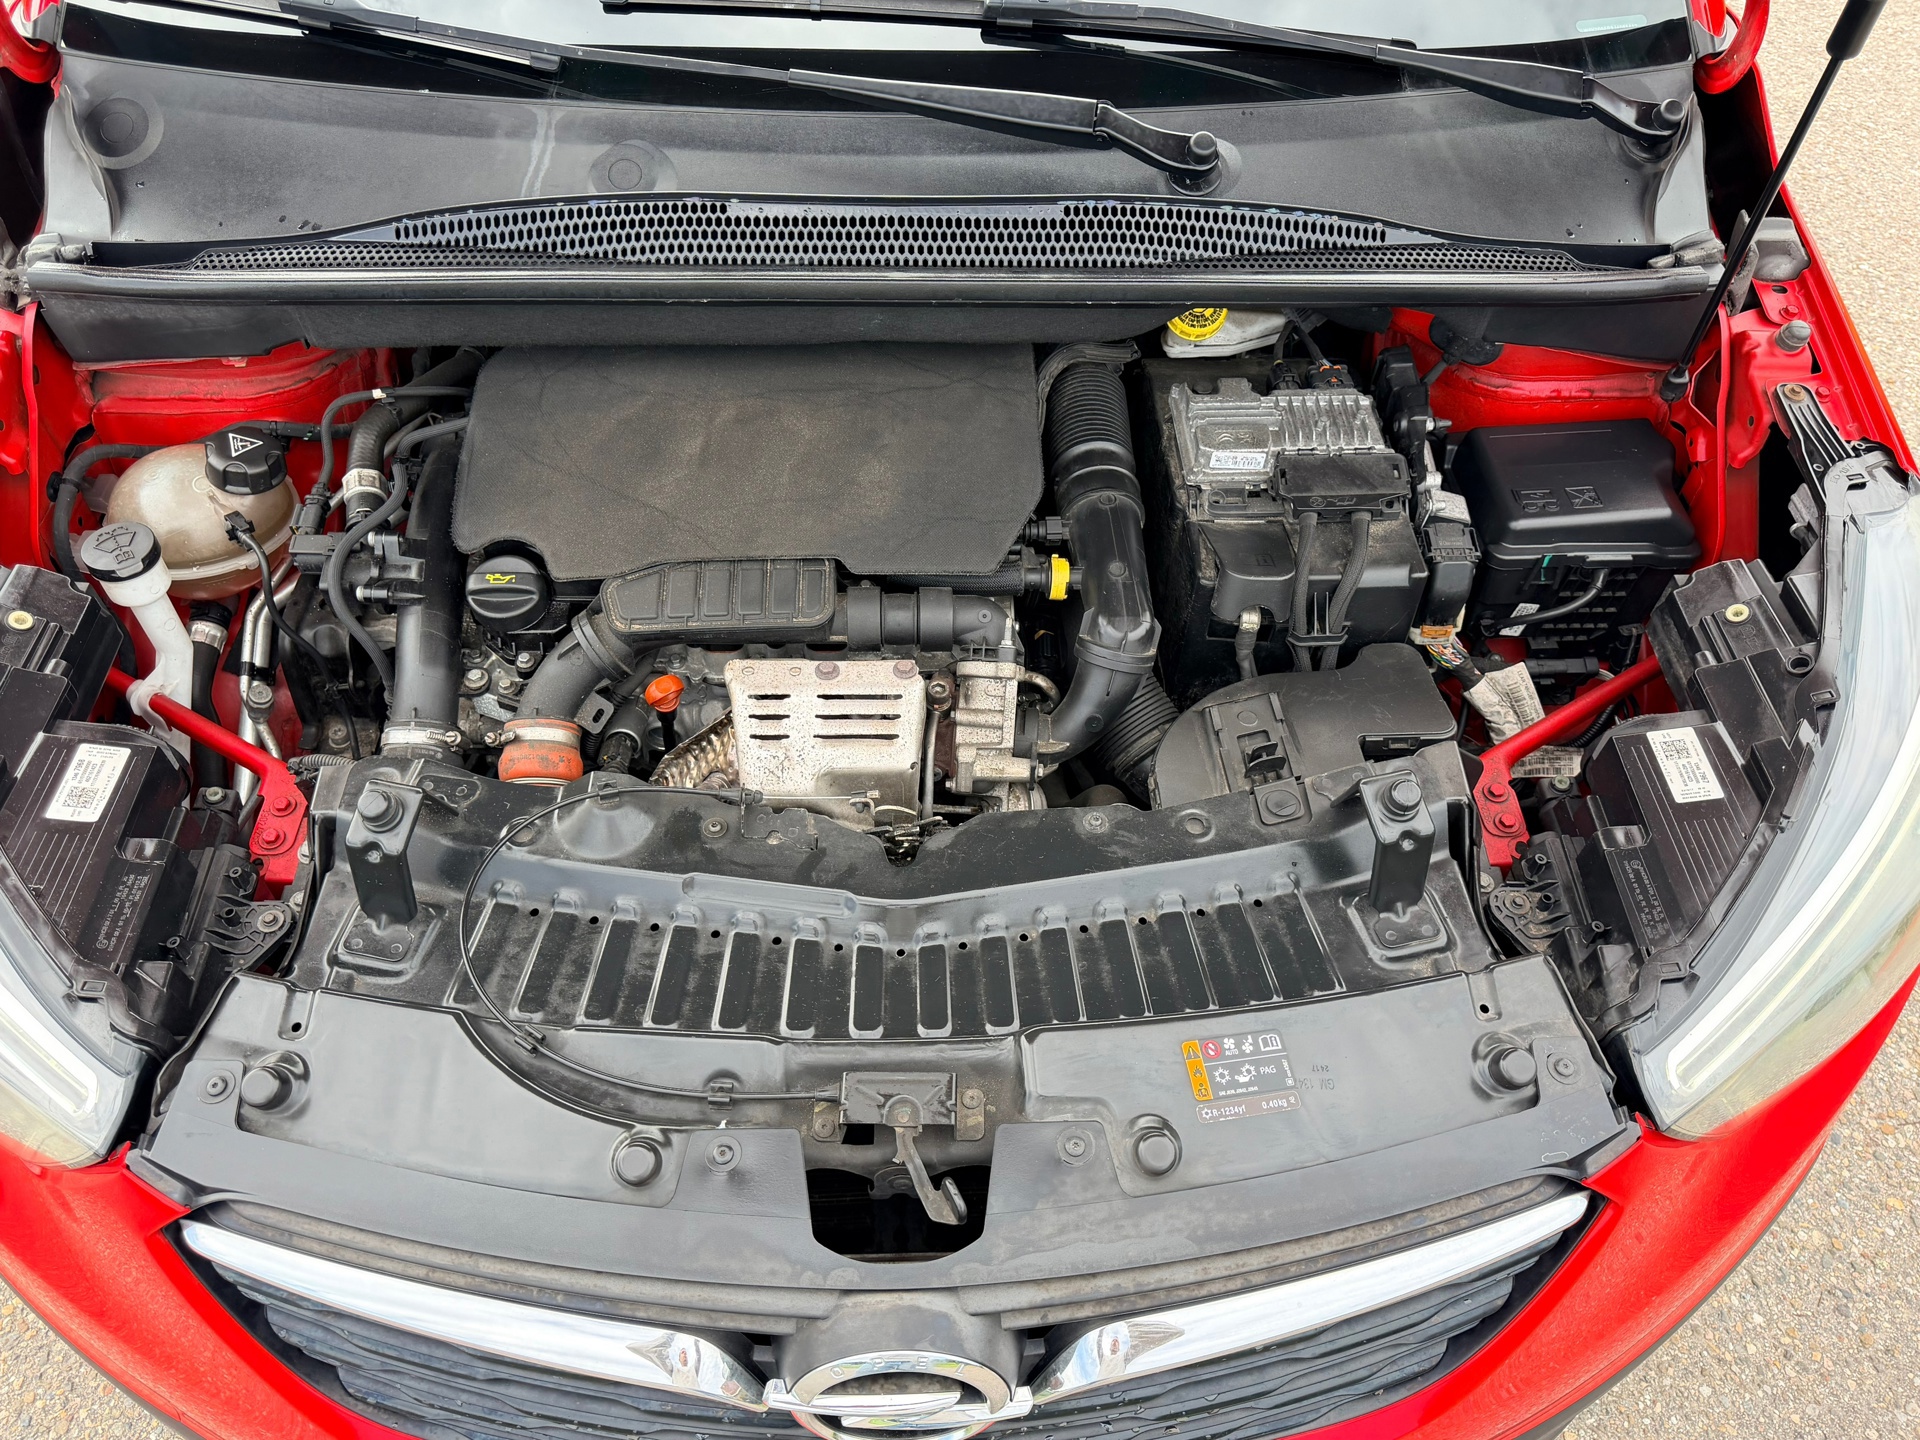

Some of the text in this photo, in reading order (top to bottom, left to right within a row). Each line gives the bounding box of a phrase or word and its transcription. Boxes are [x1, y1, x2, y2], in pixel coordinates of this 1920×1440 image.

[1260, 1065, 1276, 1074] PAG
[1320, 1078, 1335, 1090] GM
[1212, 1105, 1246, 1117] R-1234yf
[830, 1356, 965, 1378] OPEL
